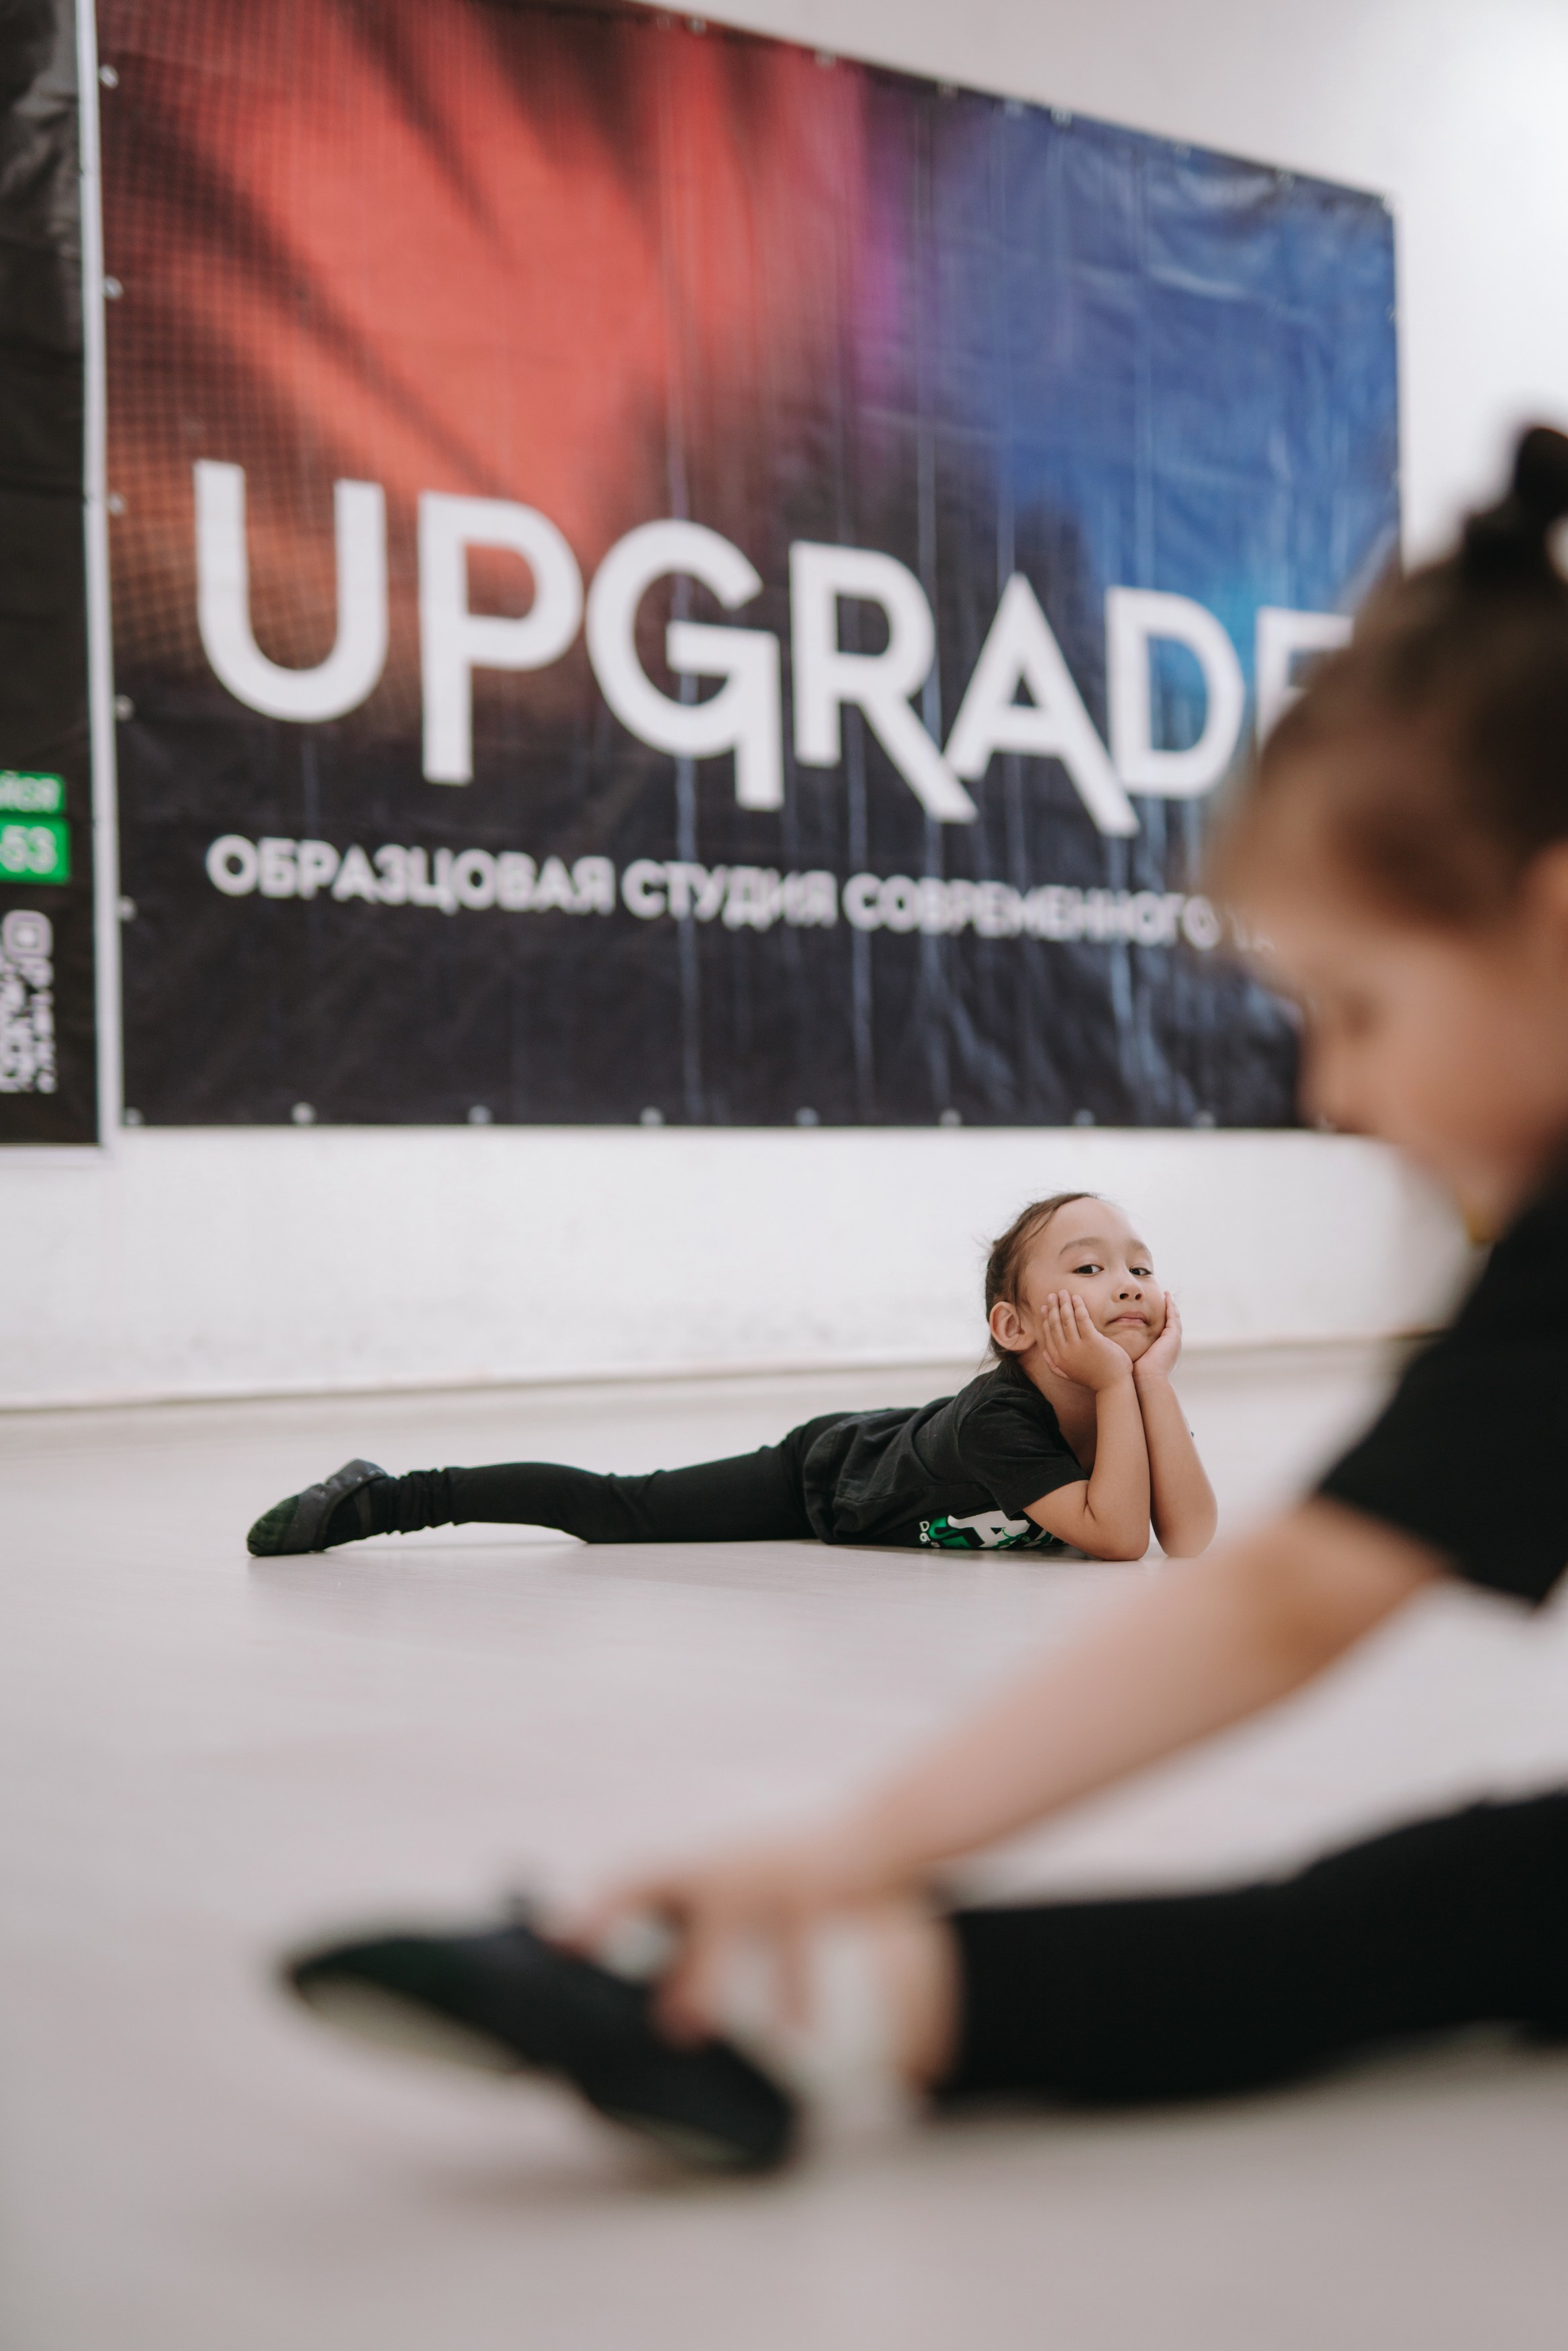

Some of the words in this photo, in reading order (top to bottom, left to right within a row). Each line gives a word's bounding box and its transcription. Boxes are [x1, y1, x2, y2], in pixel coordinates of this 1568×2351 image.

[206, 835, 615, 915] ОБРАЗЦОВАЯ
[622, 858, 838, 930] СТУДИЯ
[843, 873, 1221, 951] СОВРЕМЕННОГО
